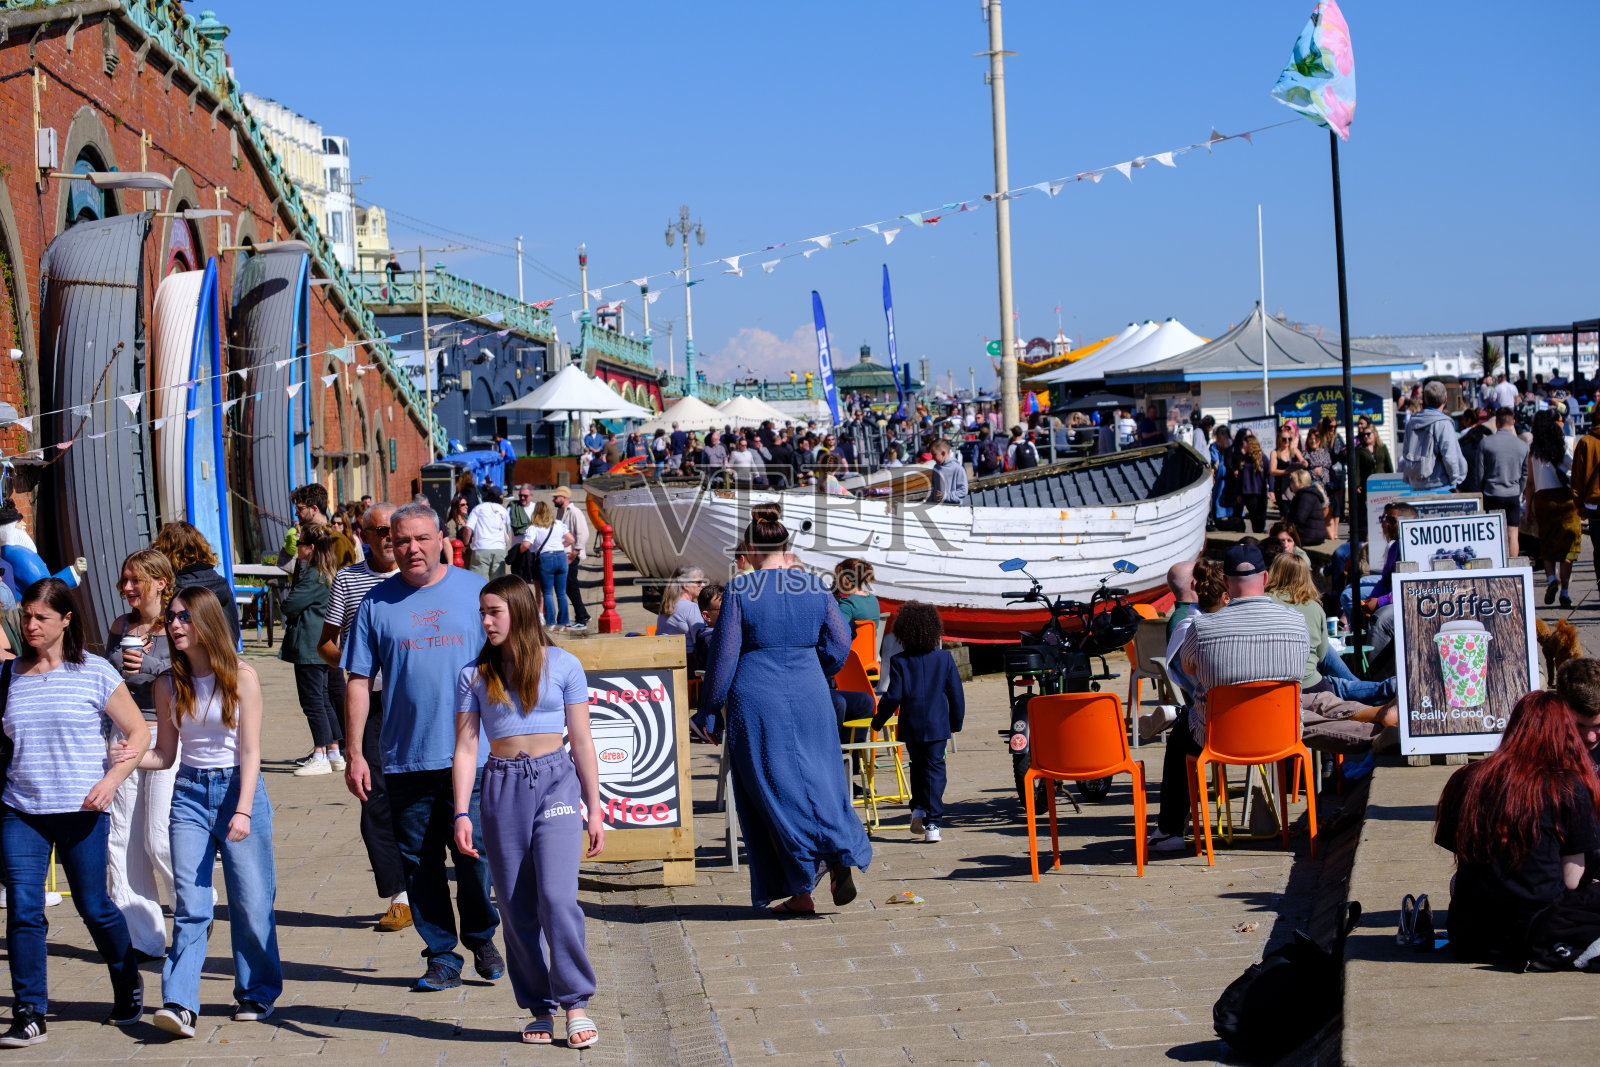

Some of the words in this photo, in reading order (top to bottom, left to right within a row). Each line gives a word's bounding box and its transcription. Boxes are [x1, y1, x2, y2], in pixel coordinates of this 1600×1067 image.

[1236, 399, 1261, 408] Oysters
[1296, 390, 1364, 409] SEAHAE
[1410, 521, 1495, 546] SMOOTHIES
[1417, 594, 1514, 619] Coffee
[606, 684, 665, 704] need
[1421, 695, 1433, 708] &
[1411, 709, 1448, 722] Really
[1451, 708, 1484, 719] Good
[602, 751, 625, 761] Great
[544, 804, 576, 819] SEOUL
